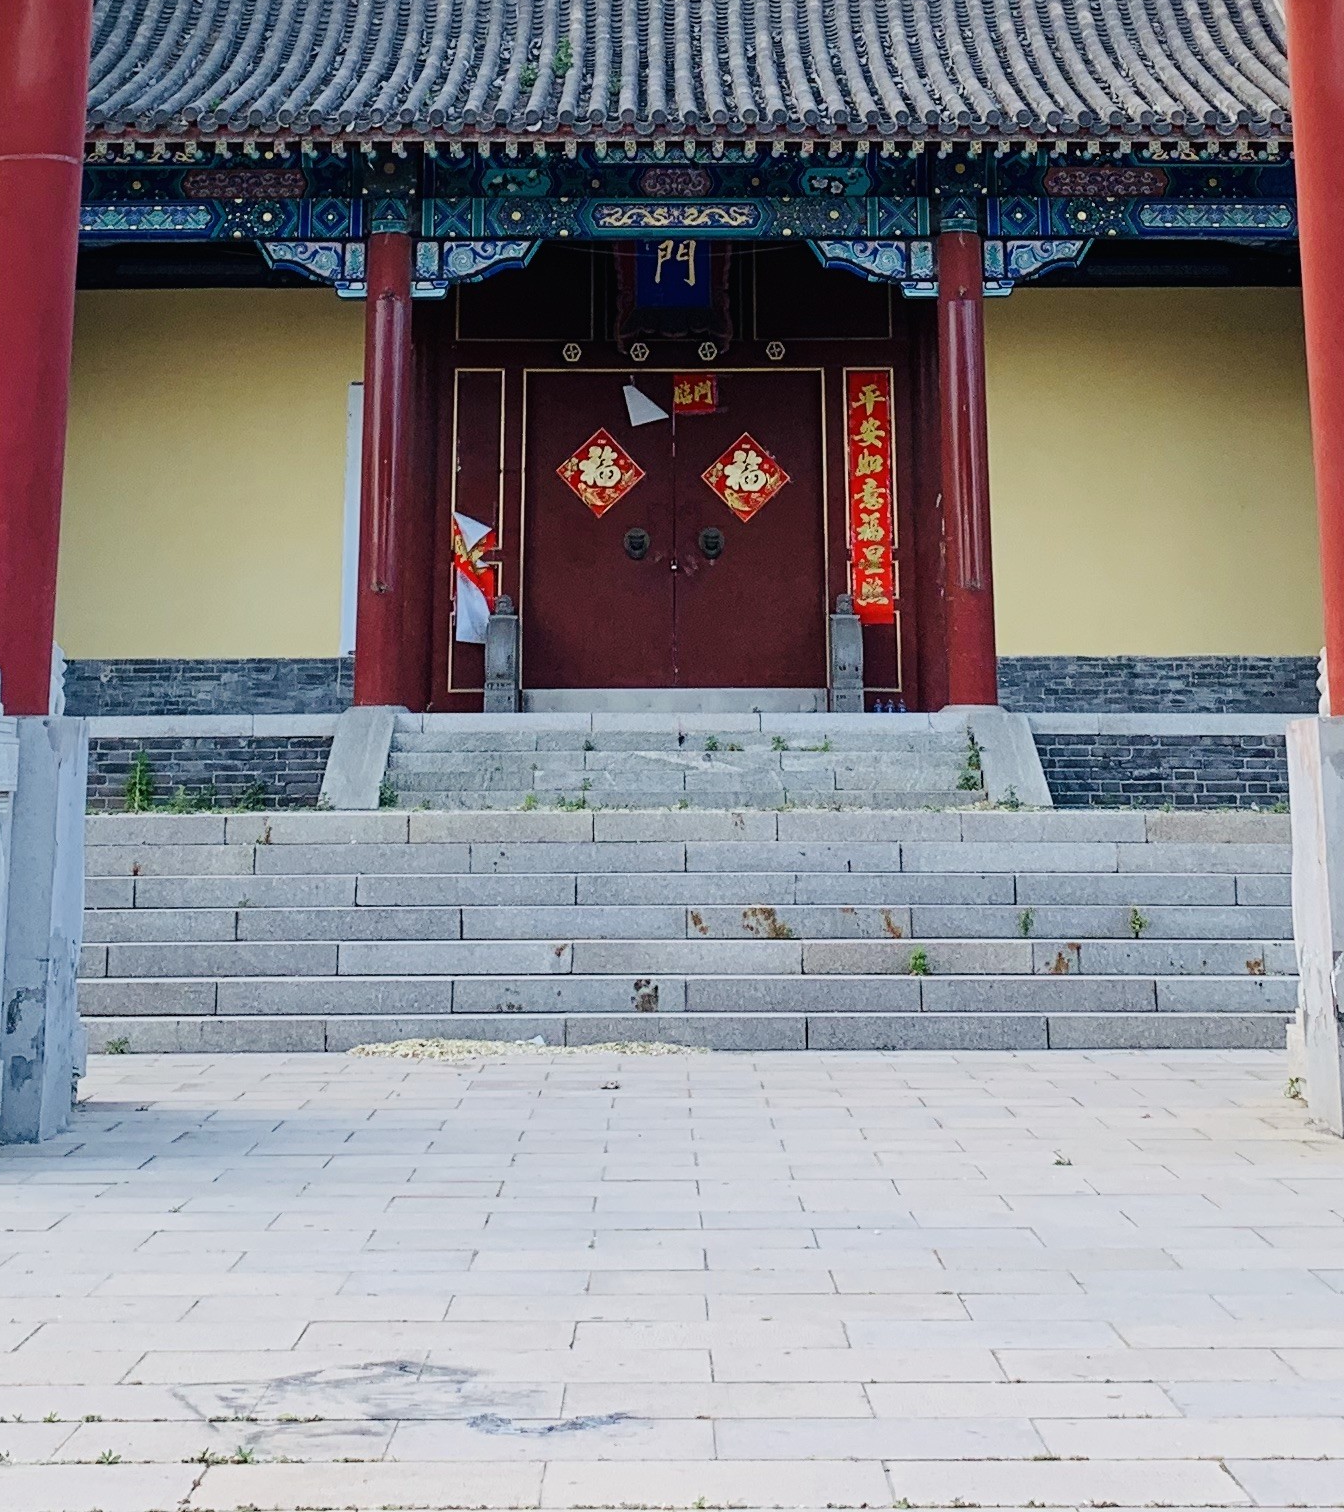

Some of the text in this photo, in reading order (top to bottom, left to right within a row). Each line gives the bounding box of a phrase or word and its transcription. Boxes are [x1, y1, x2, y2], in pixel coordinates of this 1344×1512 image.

[579, 445, 622, 488] 福
[724, 450, 767, 492] 福
[852, 384, 889, 606] 平安如意福星照
